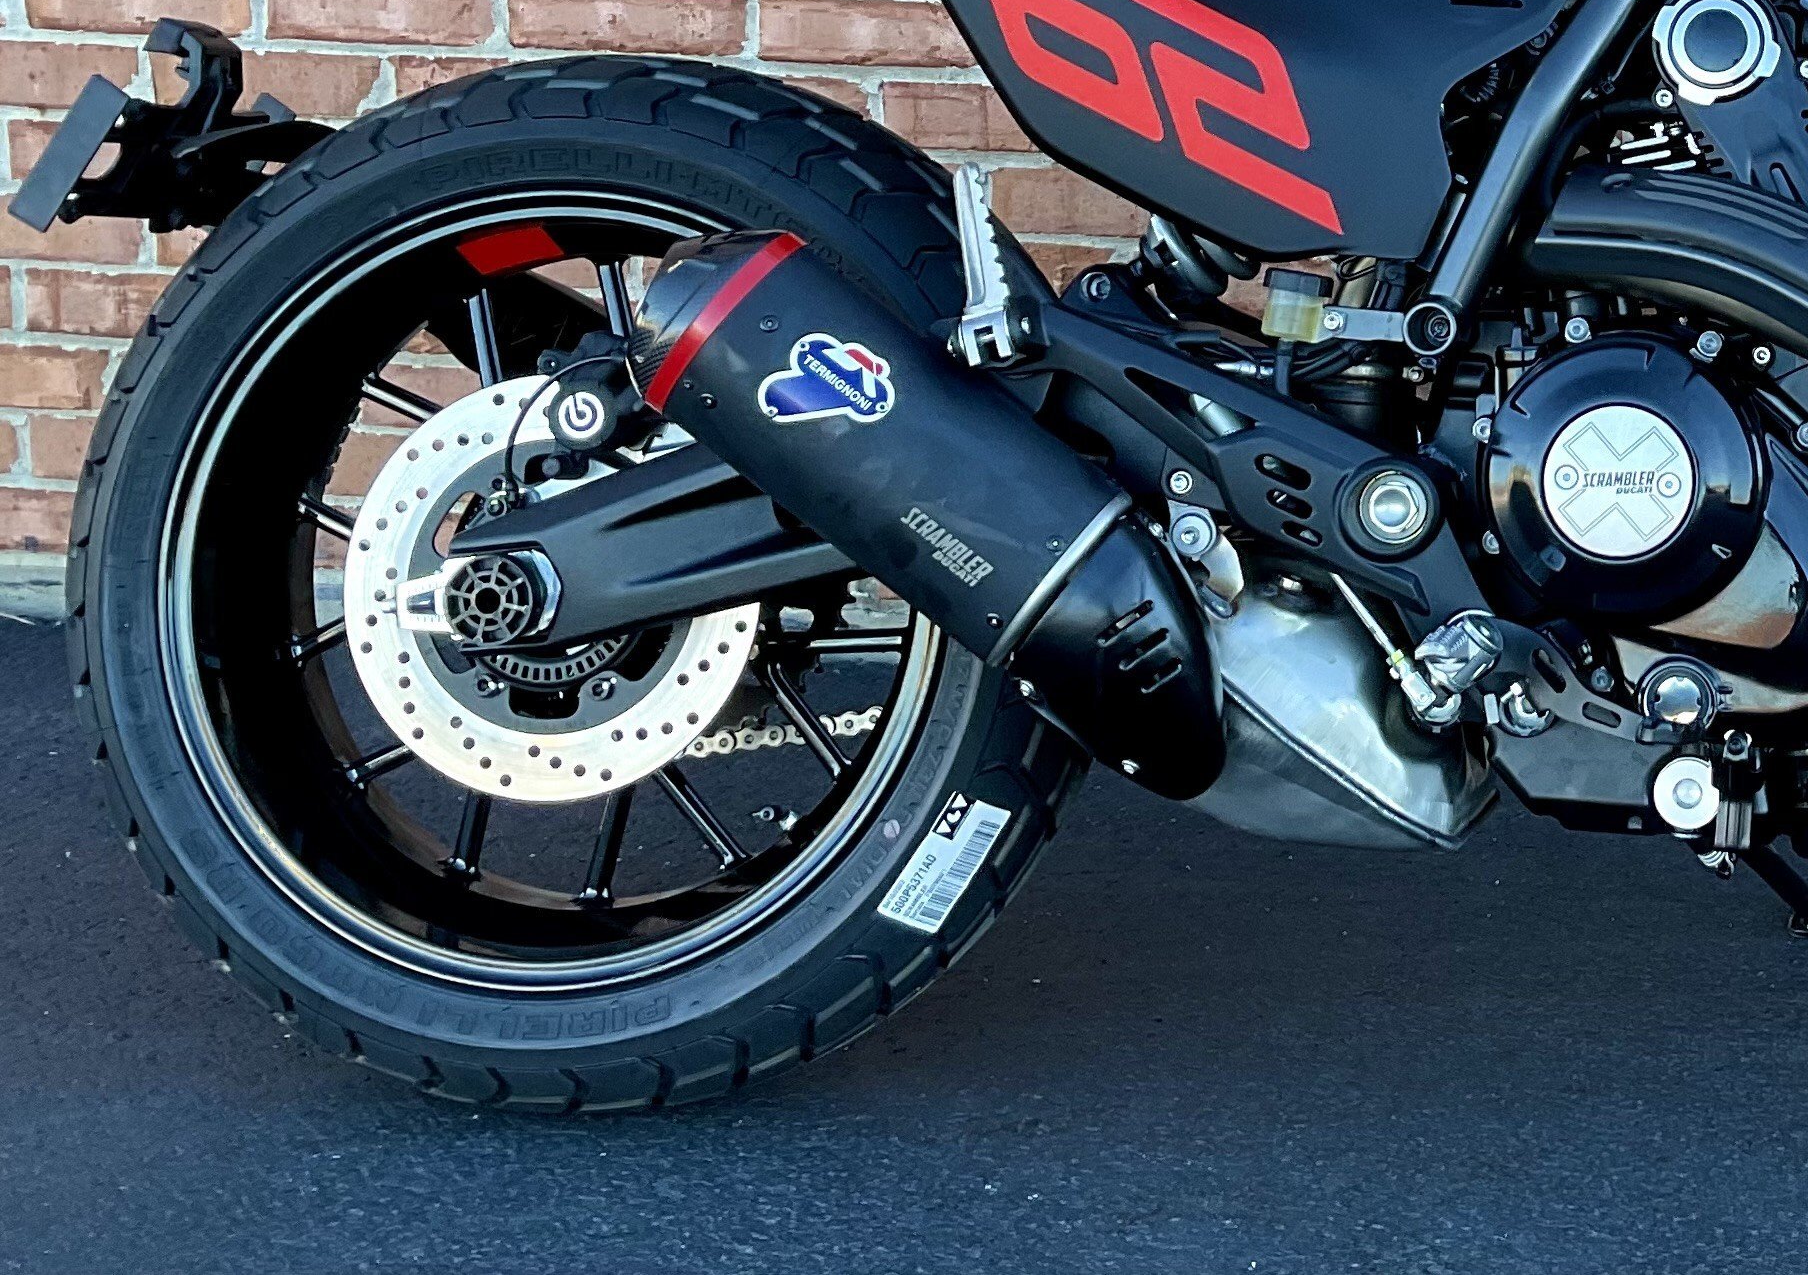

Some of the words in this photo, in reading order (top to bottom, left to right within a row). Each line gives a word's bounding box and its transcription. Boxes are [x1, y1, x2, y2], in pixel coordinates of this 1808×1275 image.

[804, 354, 873, 411] TERMIGNONI
[1583, 471, 1655, 487] SCRAMBLER
[1616, 486, 1653, 494] DUCATI
[901, 507, 994, 580] SCRAMBLER
[932, 550, 979, 587] DUCATI
